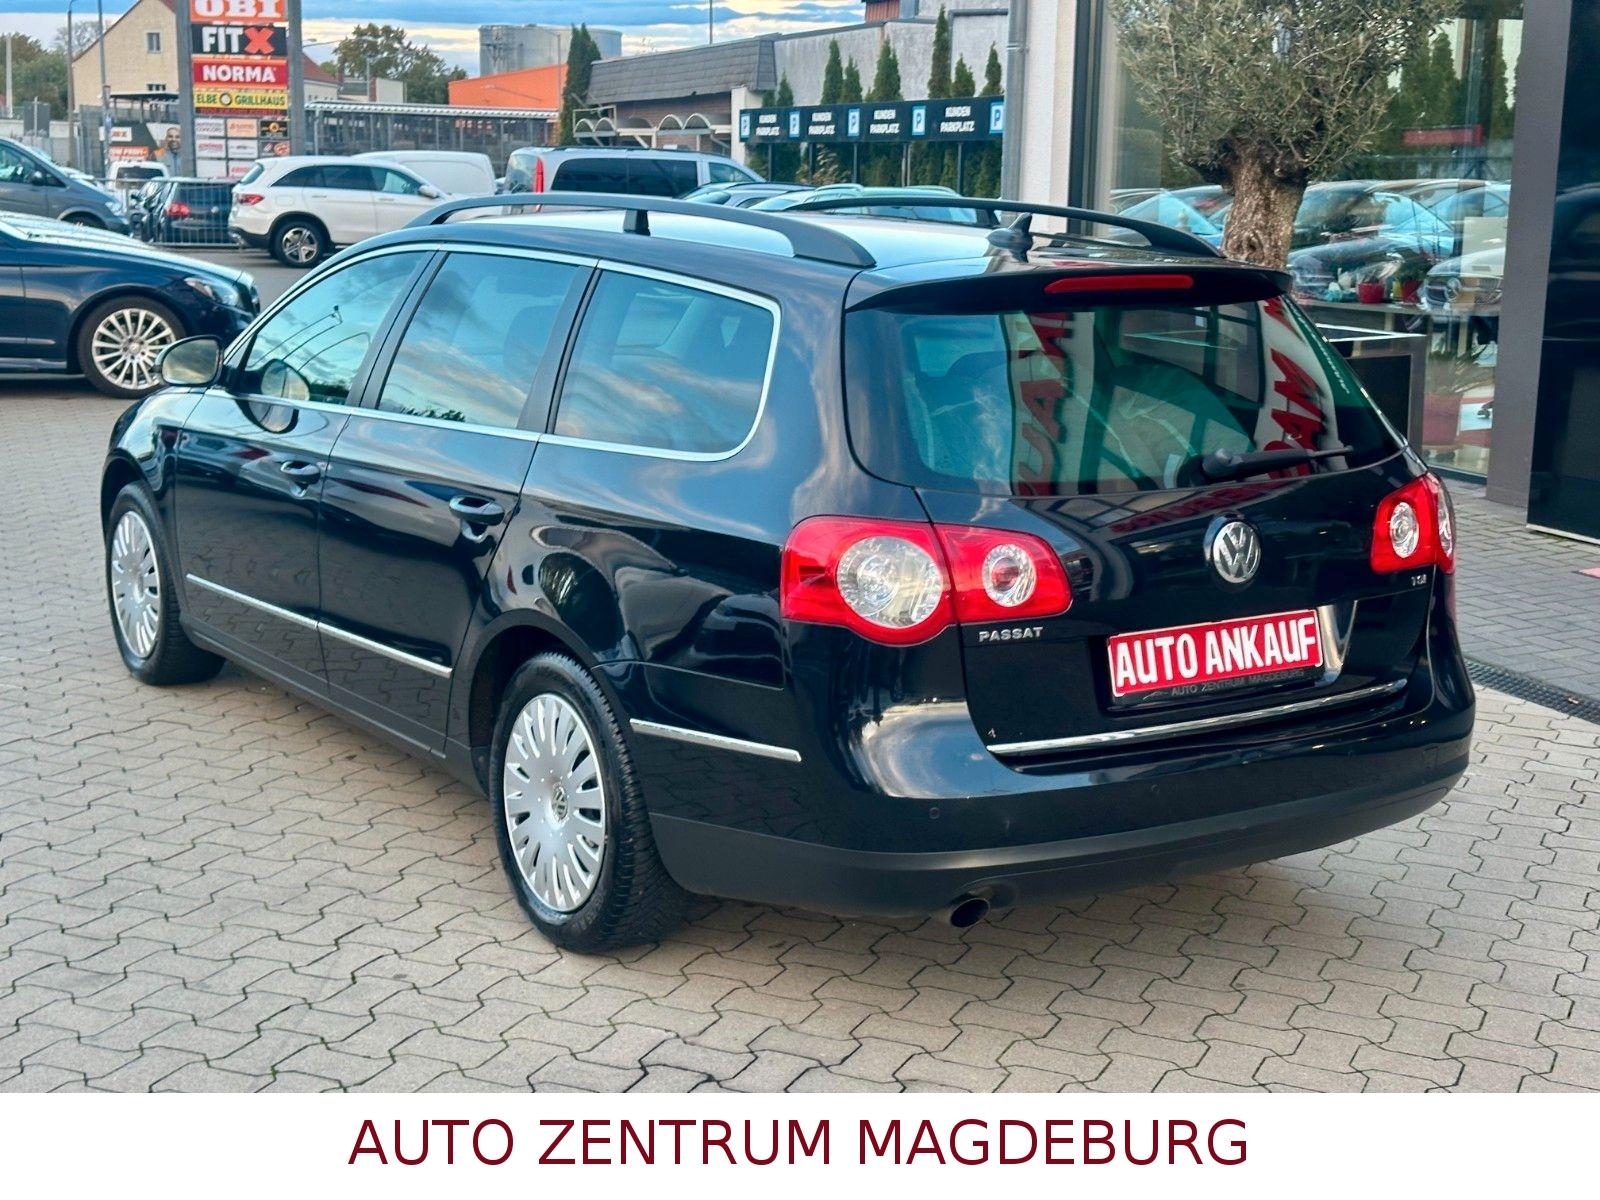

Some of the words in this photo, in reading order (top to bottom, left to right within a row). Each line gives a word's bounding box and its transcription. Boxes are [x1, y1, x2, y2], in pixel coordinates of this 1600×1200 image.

[194, 0, 281, 18] OBI
[202, 64, 276, 83] NORMA
[196, 93, 218, 104] ELBE
[234, 95, 286, 106] GRILLHAUS
[939, 120, 976, 133] PARKPLATZ
[978, 626, 1044, 643] PASSAT
[1116, 633, 1198, 688] AUTO
[1205, 616, 1317, 676] ANKAUF
[1171, 684, 1198, 697] AUTO
[1201, 678, 1246, 692] ZENTRUM
